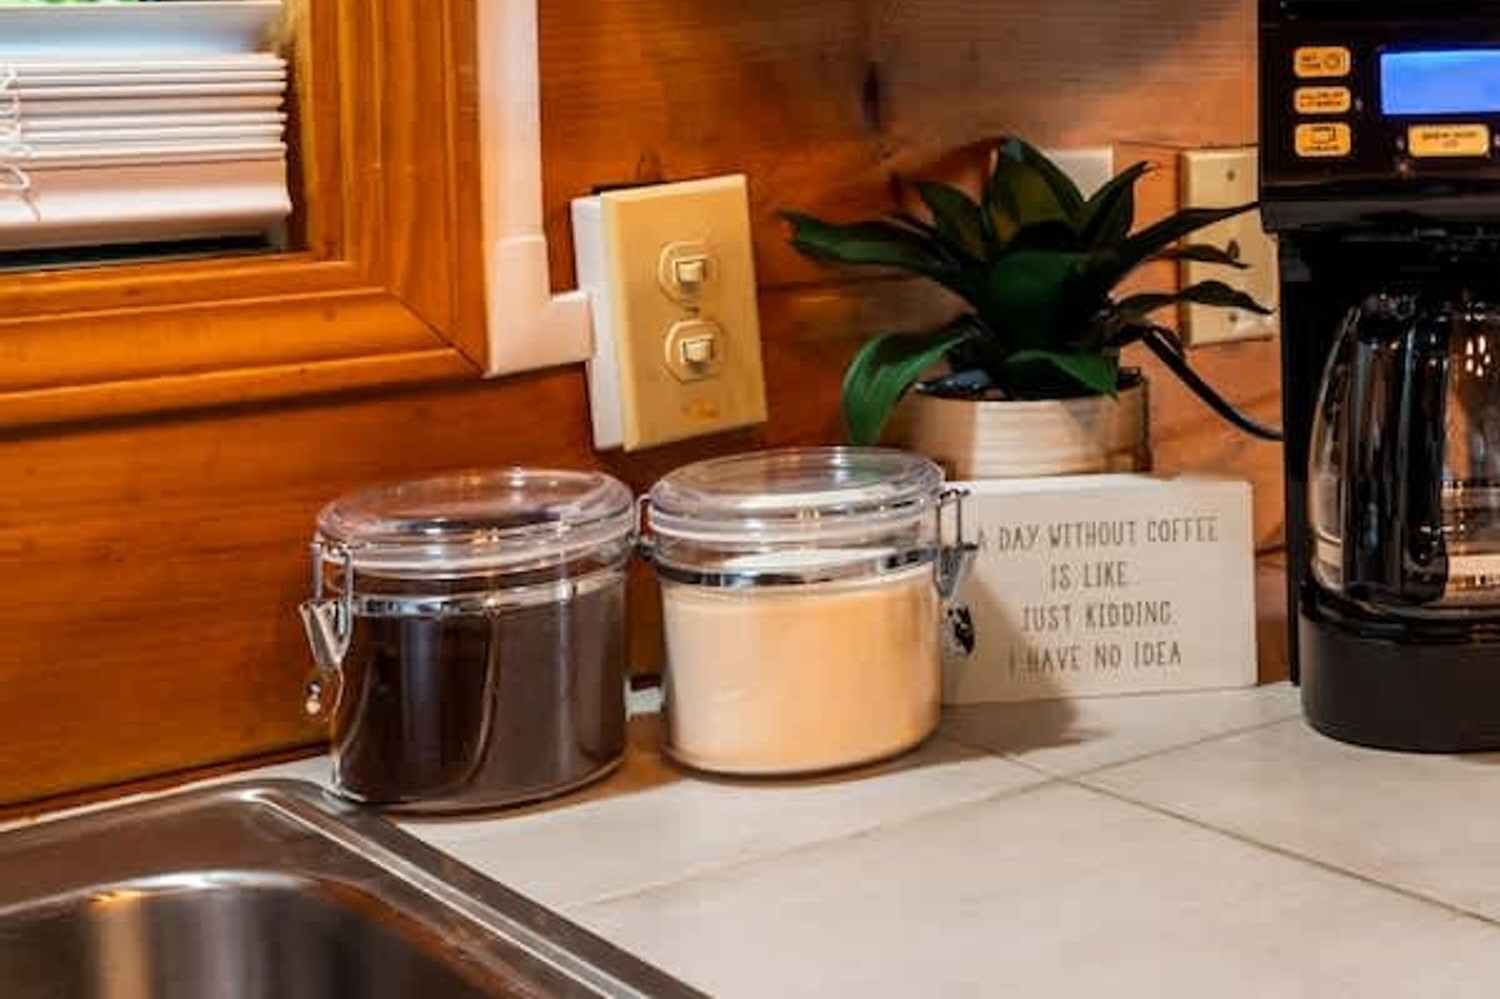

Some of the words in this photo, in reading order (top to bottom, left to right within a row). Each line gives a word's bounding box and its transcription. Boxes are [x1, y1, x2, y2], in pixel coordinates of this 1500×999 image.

[999, 525, 1041, 551] DAY
[1048, 520, 1136, 548] WITHOUT
[1147, 516, 1219, 542] COFFEE
[1051, 562, 1071, 591] IS
[1022, 604, 1072, 632] JUST
[1026, 645, 1081, 673] HAVE
[1094, 642, 1122, 669] NO
[1133, 640, 1181, 668] IDEA
